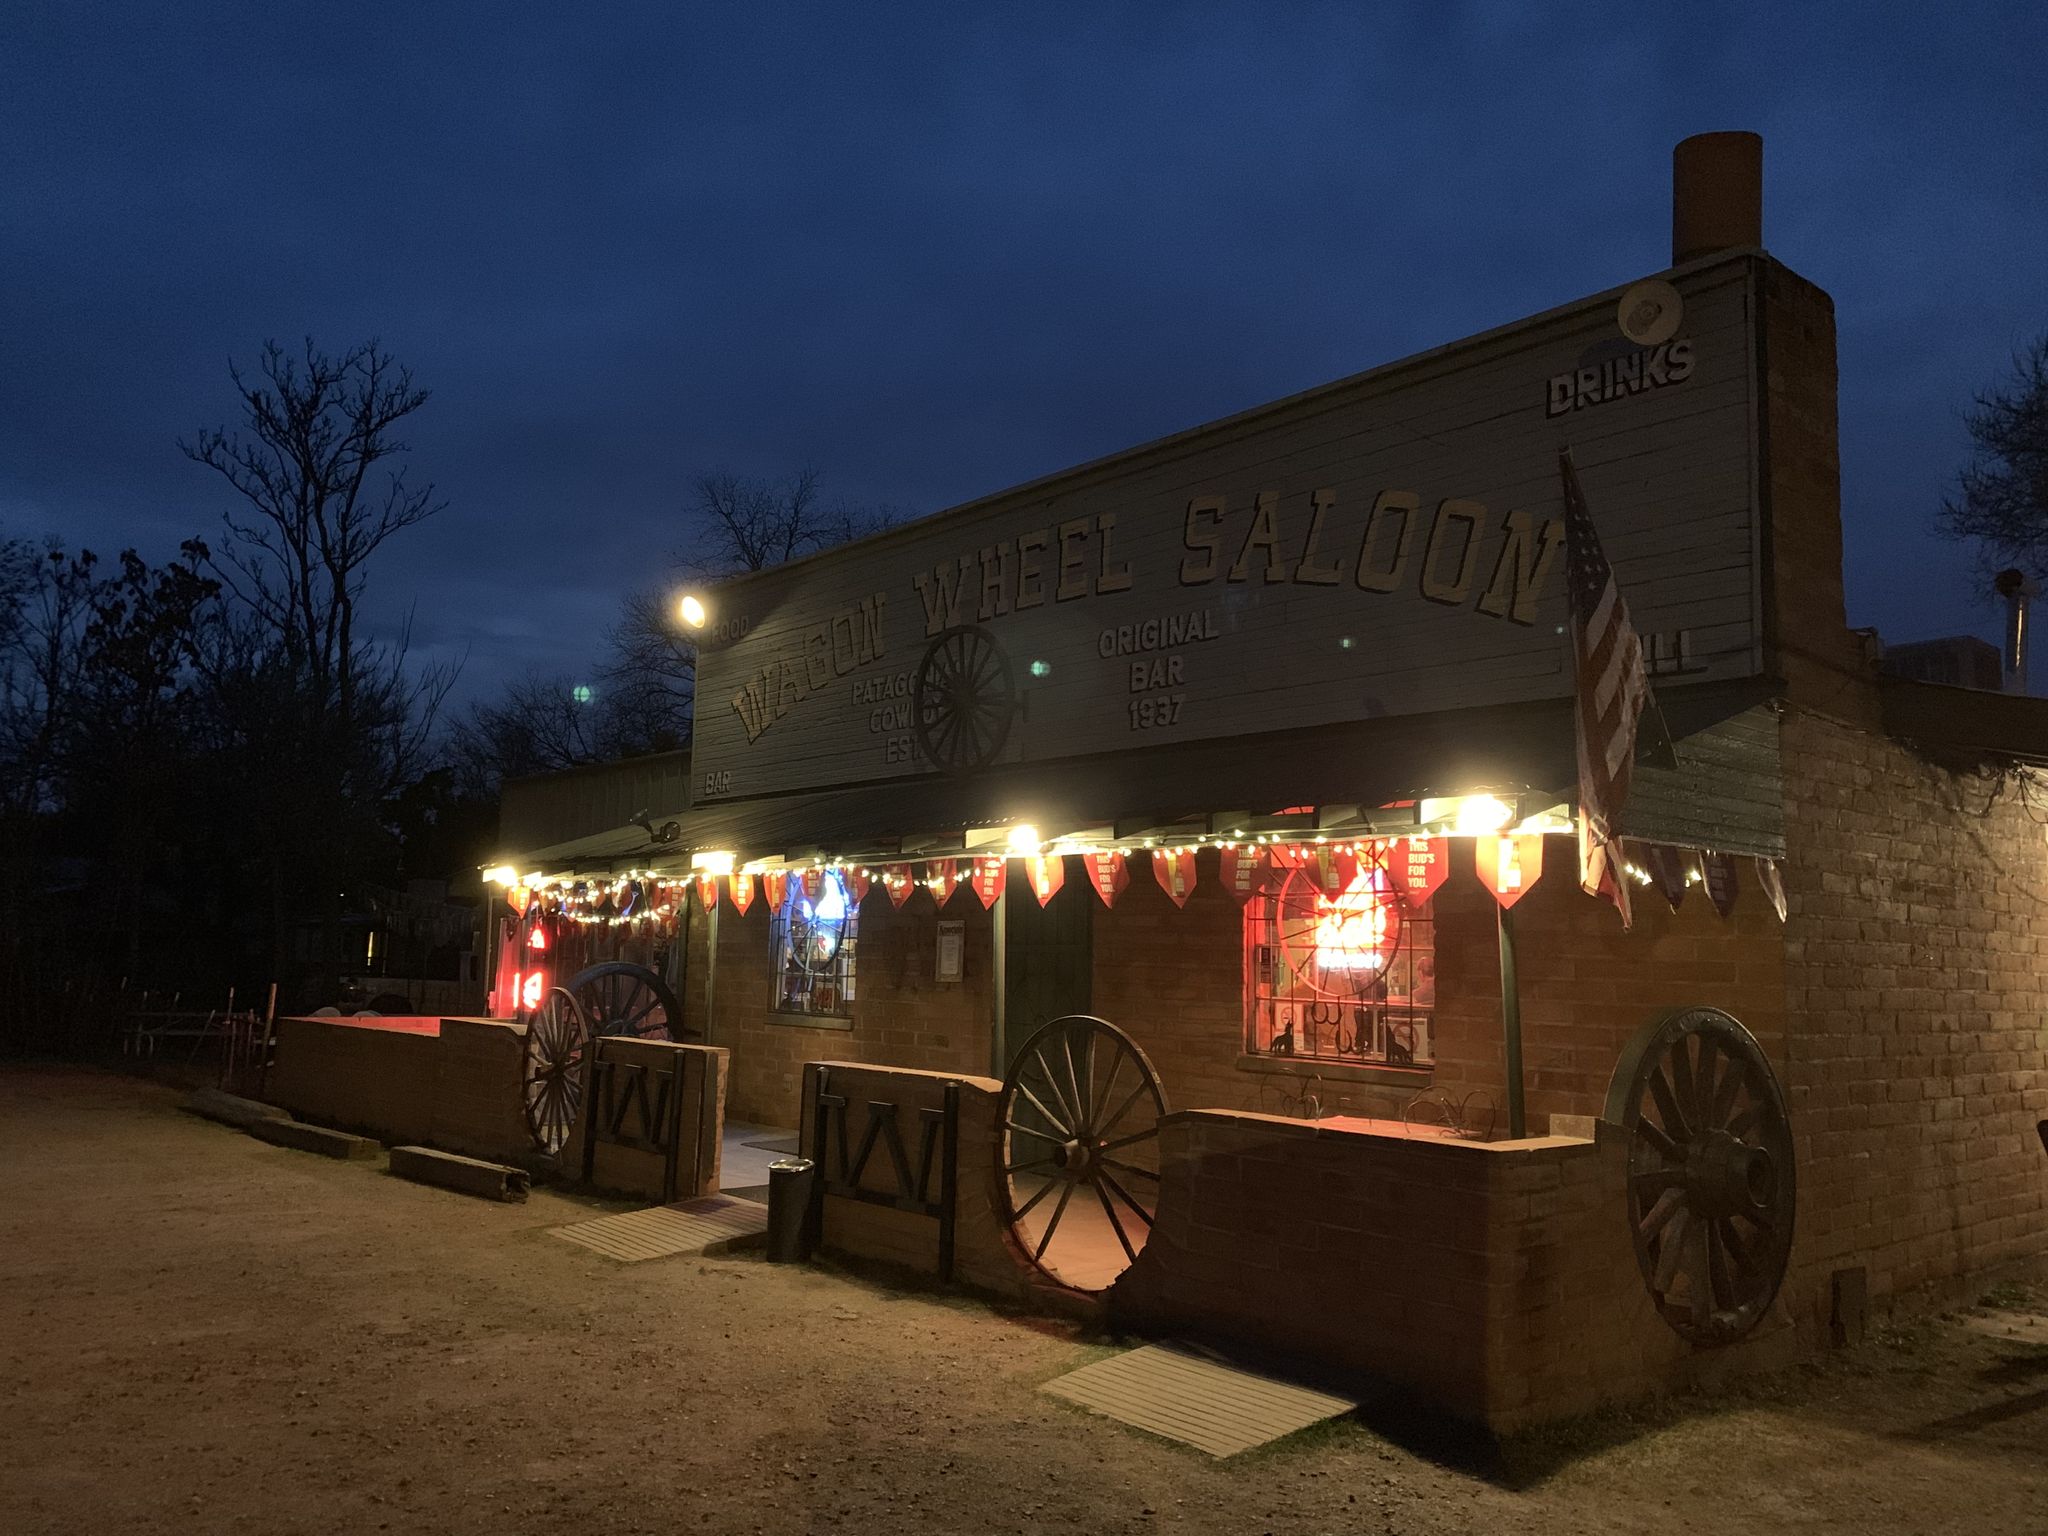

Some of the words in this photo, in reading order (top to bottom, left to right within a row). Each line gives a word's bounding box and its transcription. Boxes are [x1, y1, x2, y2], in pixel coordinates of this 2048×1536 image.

[1546, 338, 1696, 419] DRINKS
[711, 615, 749, 642] FOOD
[731, 592, 886, 745] WAGON
[912, 512, 1134, 639] WHEEL
[1179, 488, 1566, 627] SALOON
[1098, 609, 1220, 659] ORIGINAL
[1129, 655, 1186, 694] BAR
[1128, 694, 1187, 731] 1937
[704, 771, 731, 796] BAR
[1408, 853, 1435, 864] BUD'S
[1408, 865, 1426, 876] FOR
[1408, 877, 1429, 888] YOU.
